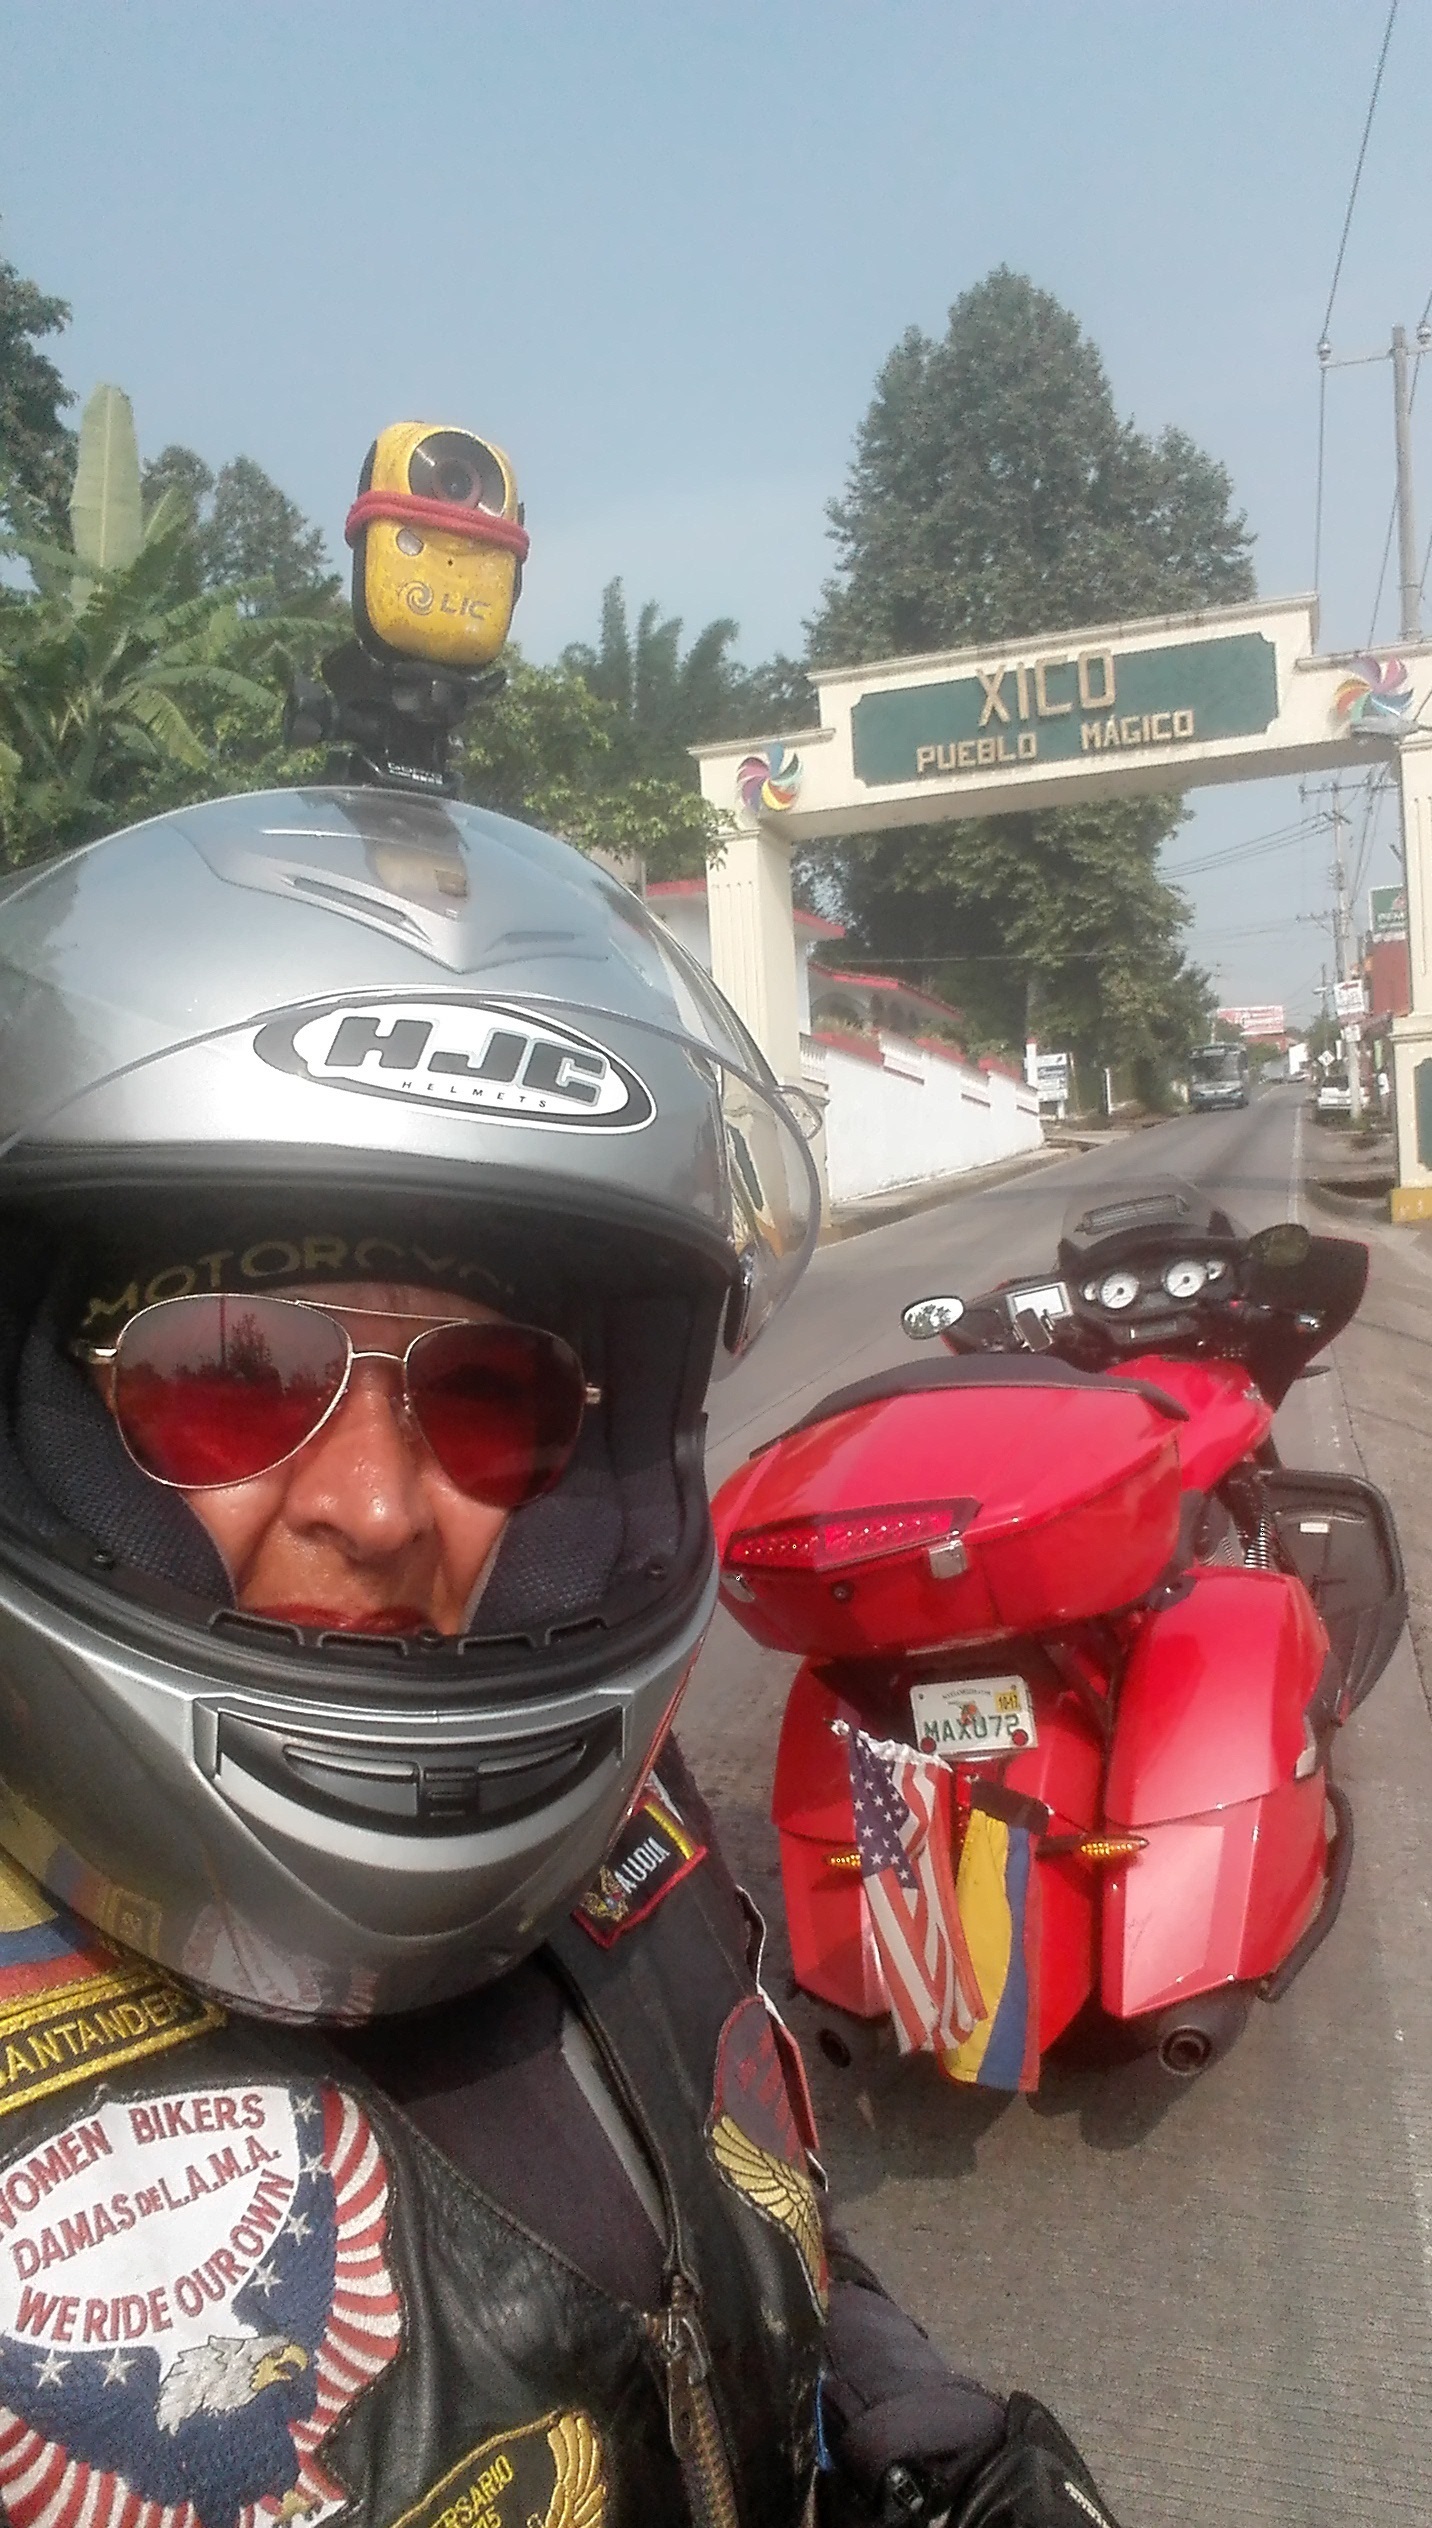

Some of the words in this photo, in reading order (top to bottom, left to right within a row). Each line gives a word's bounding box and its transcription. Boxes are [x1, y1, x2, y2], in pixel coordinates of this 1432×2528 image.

[976, 648, 1116, 727] XICO
[917, 731, 1037, 773] PUEBLO
[1081, 708, 1195, 750] MÁGICO
[324, 1015, 606, 1107] HJC
[401, 1081, 547, 1109] HELMETS
[0, 1988, 188, 2088] ANTANDER
[128, 2093, 266, 2146] BIKERS
[11, 2193, 137, 2281] DAMAS
[15, 2285, 81, 2342] WE
[83, 2286, 174, 2343] RIDE
[174, 2247, 250, 2317] OUR
[229, 2168, 295, 2258] OWN
